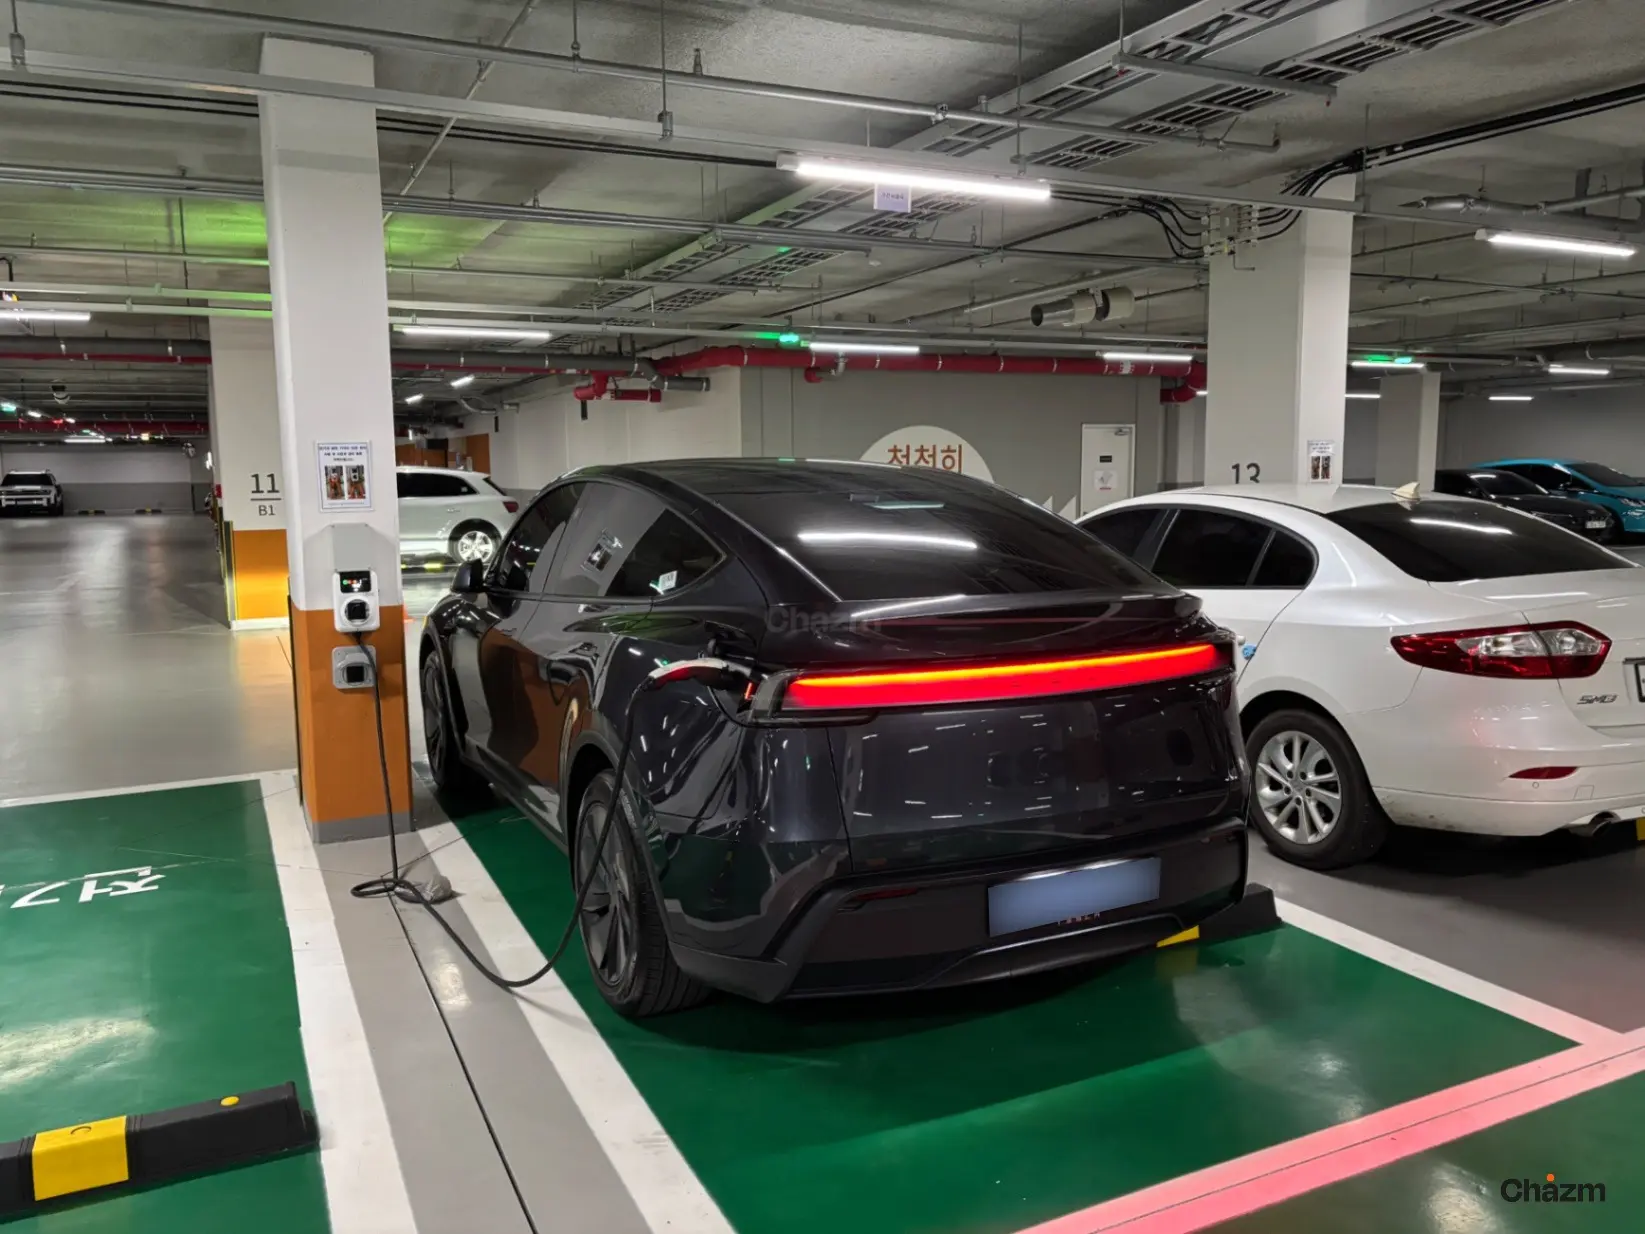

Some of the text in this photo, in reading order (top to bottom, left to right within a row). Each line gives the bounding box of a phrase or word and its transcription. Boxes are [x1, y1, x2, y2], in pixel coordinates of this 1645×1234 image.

[888, 444, 963, 474] 천천히
[251, 473, 280, 494] 11
[258, 504, 276, 516] B1
